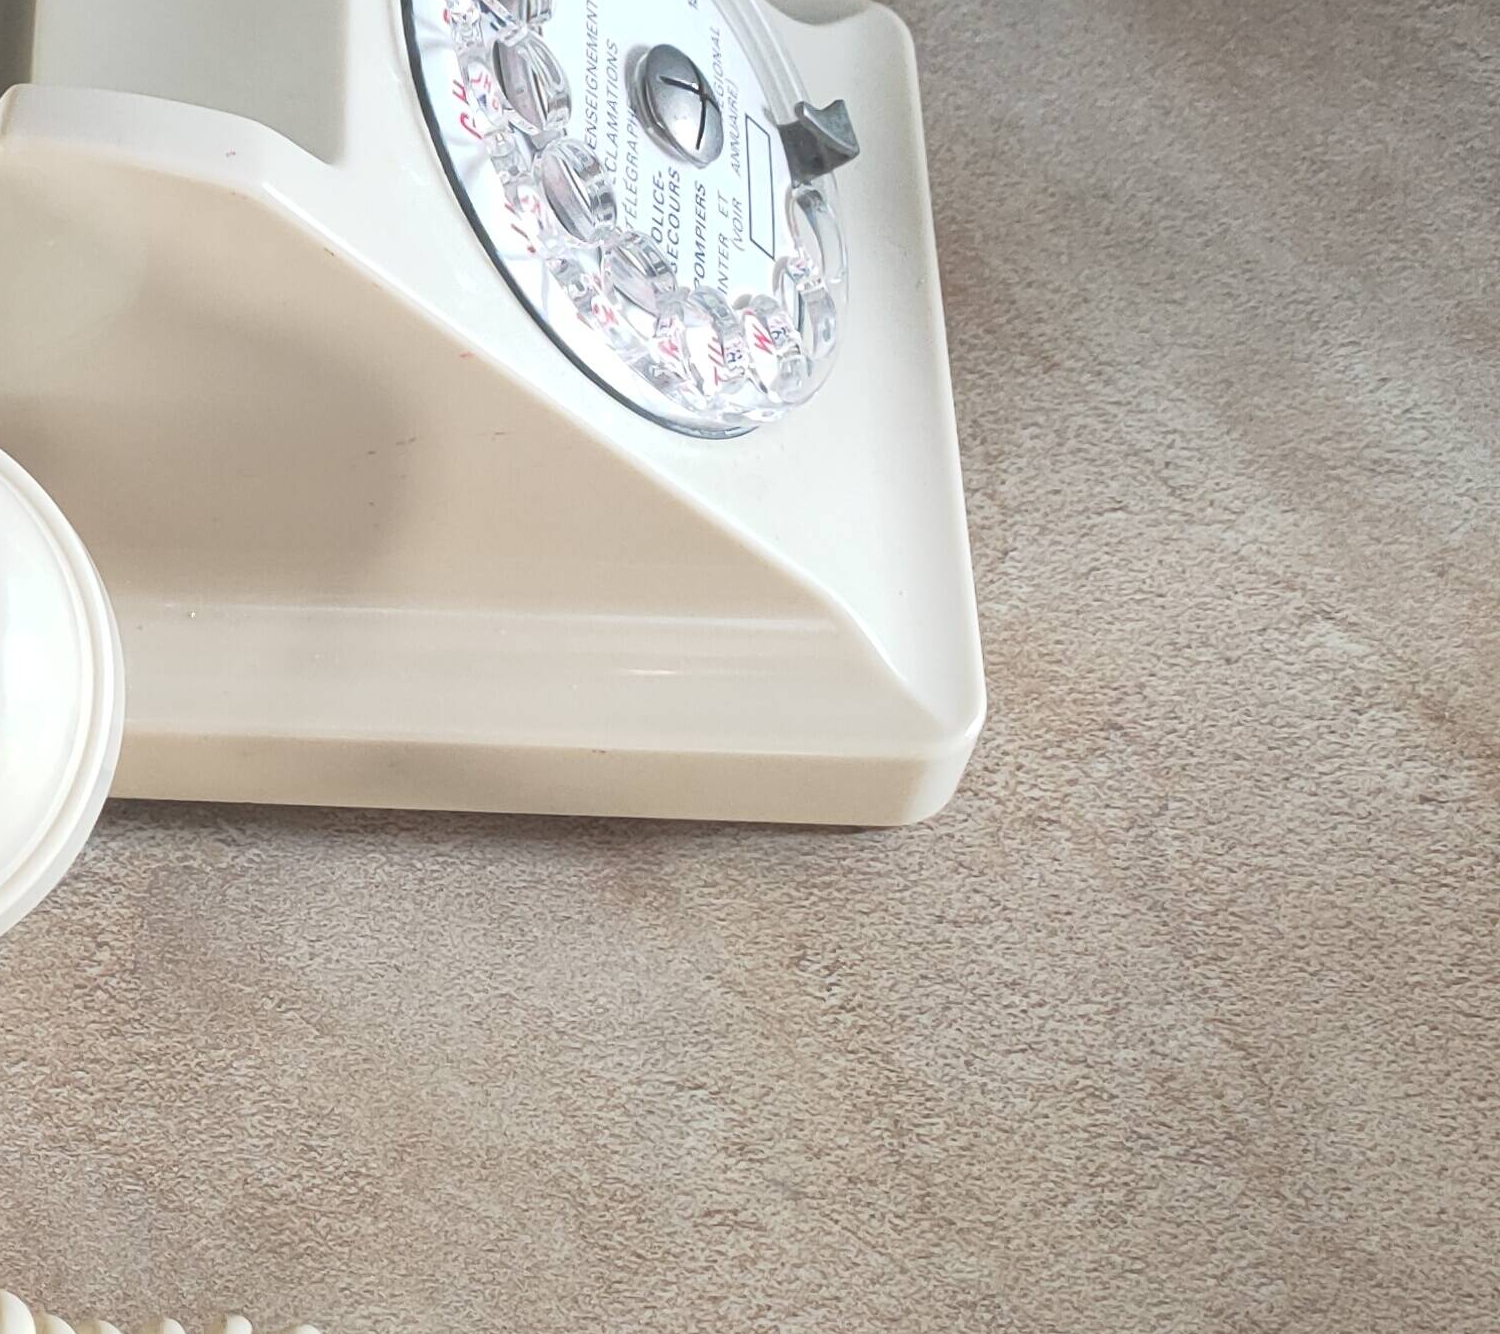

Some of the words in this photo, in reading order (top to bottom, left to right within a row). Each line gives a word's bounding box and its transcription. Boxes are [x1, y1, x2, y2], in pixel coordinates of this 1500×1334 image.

[710, 27, 725, 113] GIONAL
[604, 38, 619, 185] CLAMATIONS
[729, 77, 742, 179] ANNUAIRE)
[621, 101, 639, 230] TÉLÉGRAPH
[717, 188, 729, 218] ET
[651, 170, 665, 244] OLICE-
[729, 197, 745, 251] (VOIR
[717, 233, 729, 295] INTER
